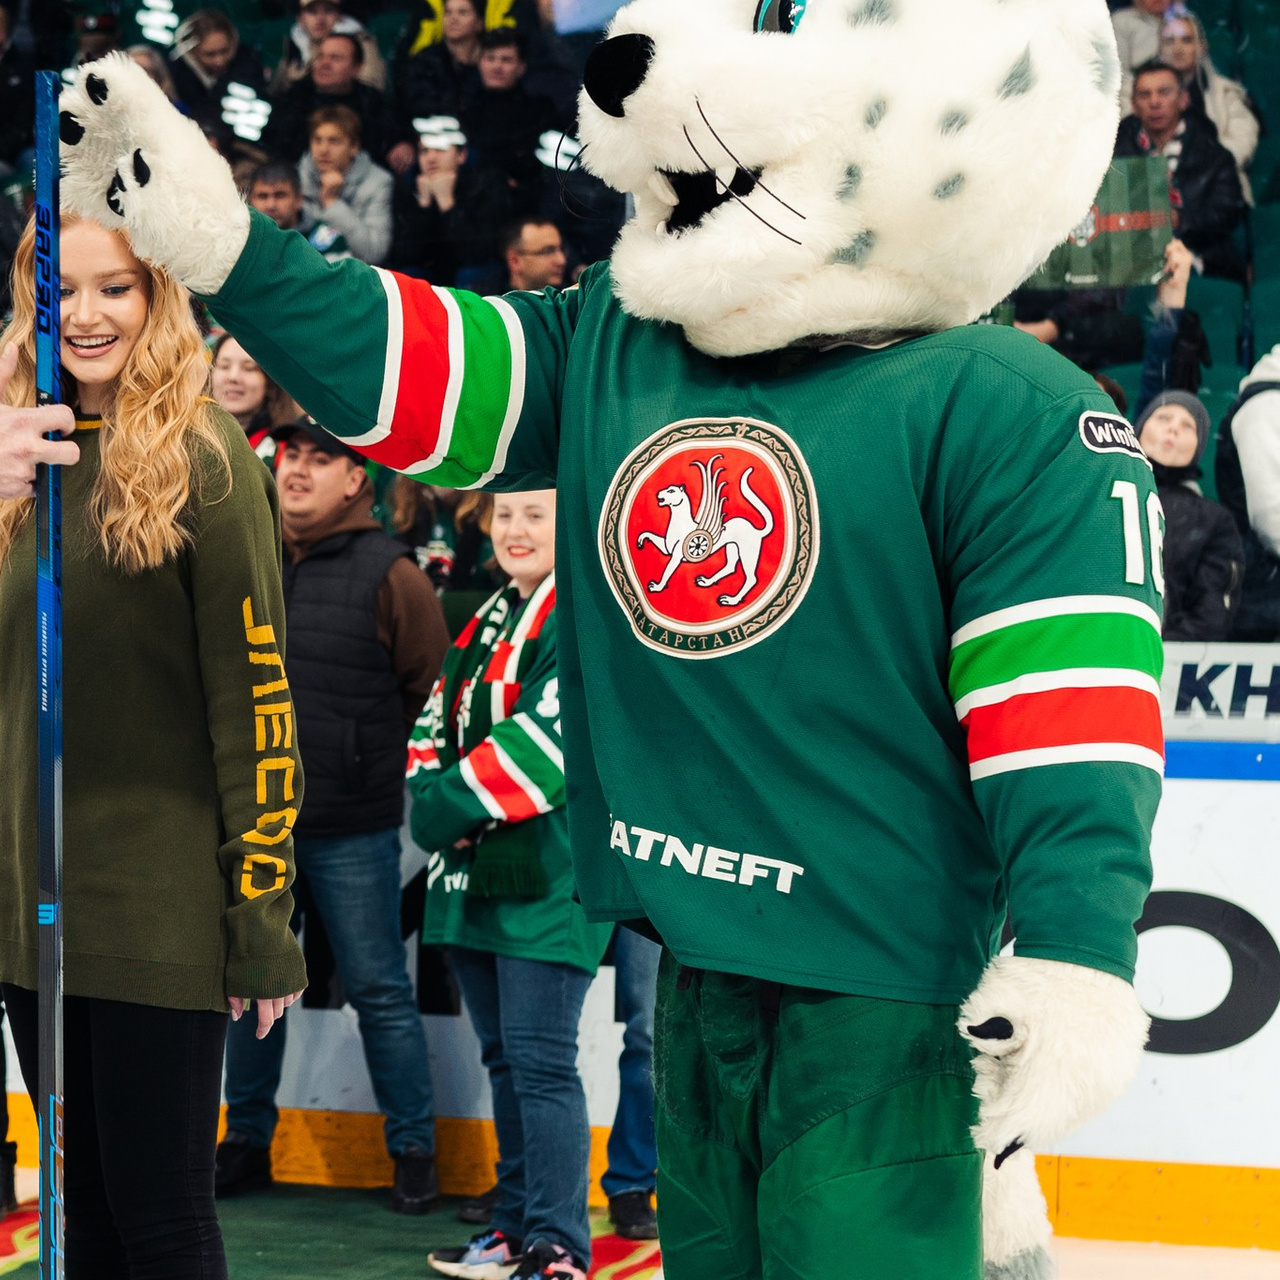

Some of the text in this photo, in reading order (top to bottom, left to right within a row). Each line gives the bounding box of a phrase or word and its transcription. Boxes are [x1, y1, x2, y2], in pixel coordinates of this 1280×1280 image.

[634, 605, 742, 650] ТАТАРСТАН
[239, 596, 297, 901] JAECOO
[609, 813, 804, 894] ATNEFT
